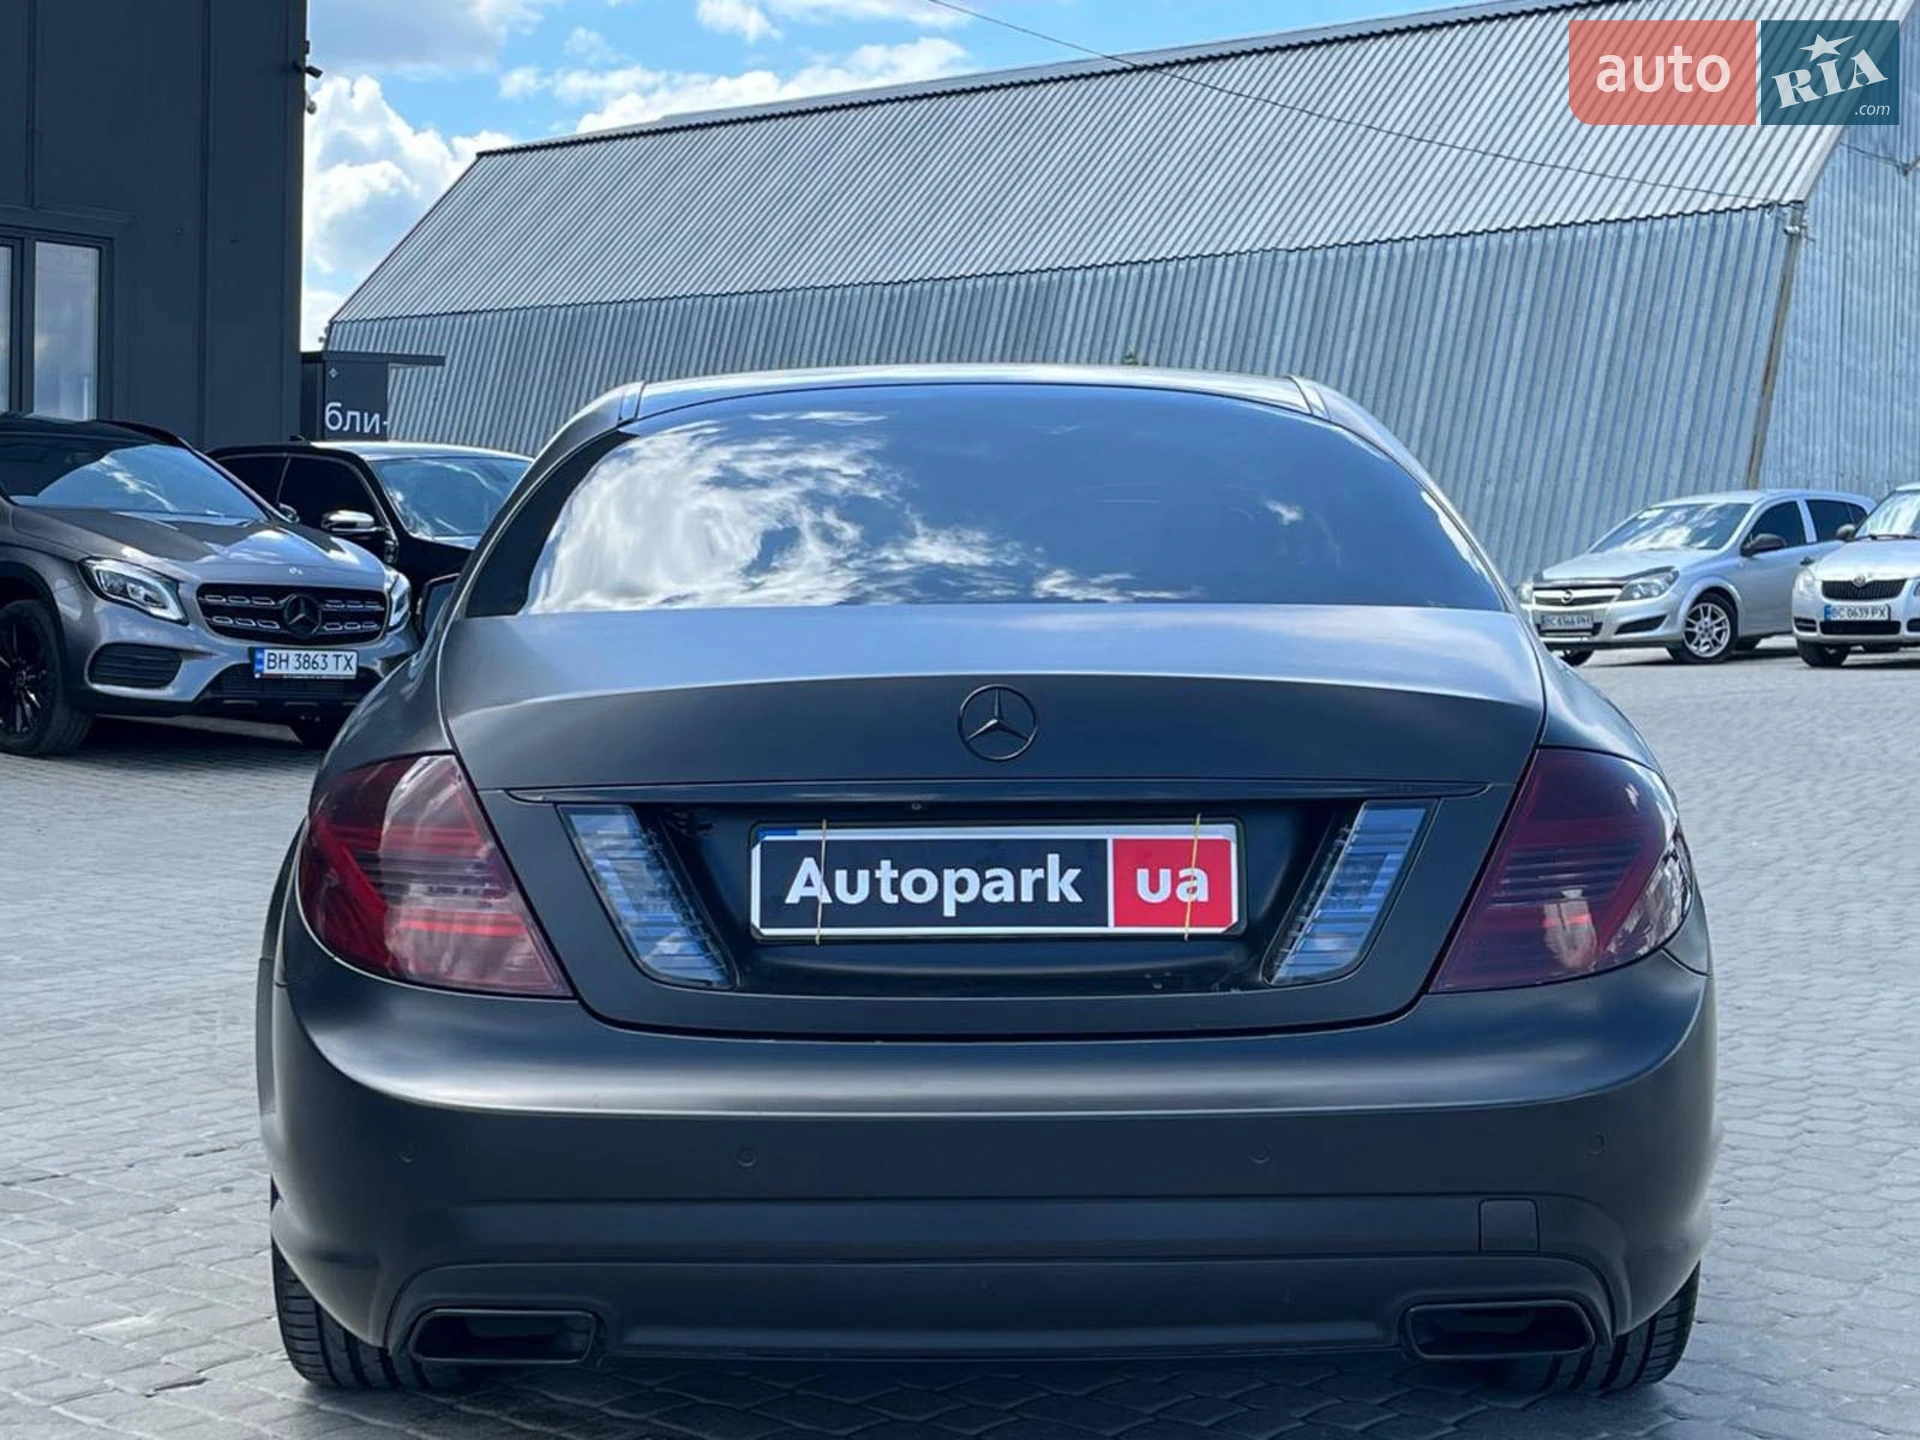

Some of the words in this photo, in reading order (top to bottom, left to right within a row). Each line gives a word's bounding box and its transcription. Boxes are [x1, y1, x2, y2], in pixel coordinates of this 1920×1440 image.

[267, 652, 289, 670] BH
[293, 653, 328, 671] 3863
[332, 653, 354, 671] TX
[784, 853, 1083, 917] Autopark
[1136, 867, 1209, 903] ua
